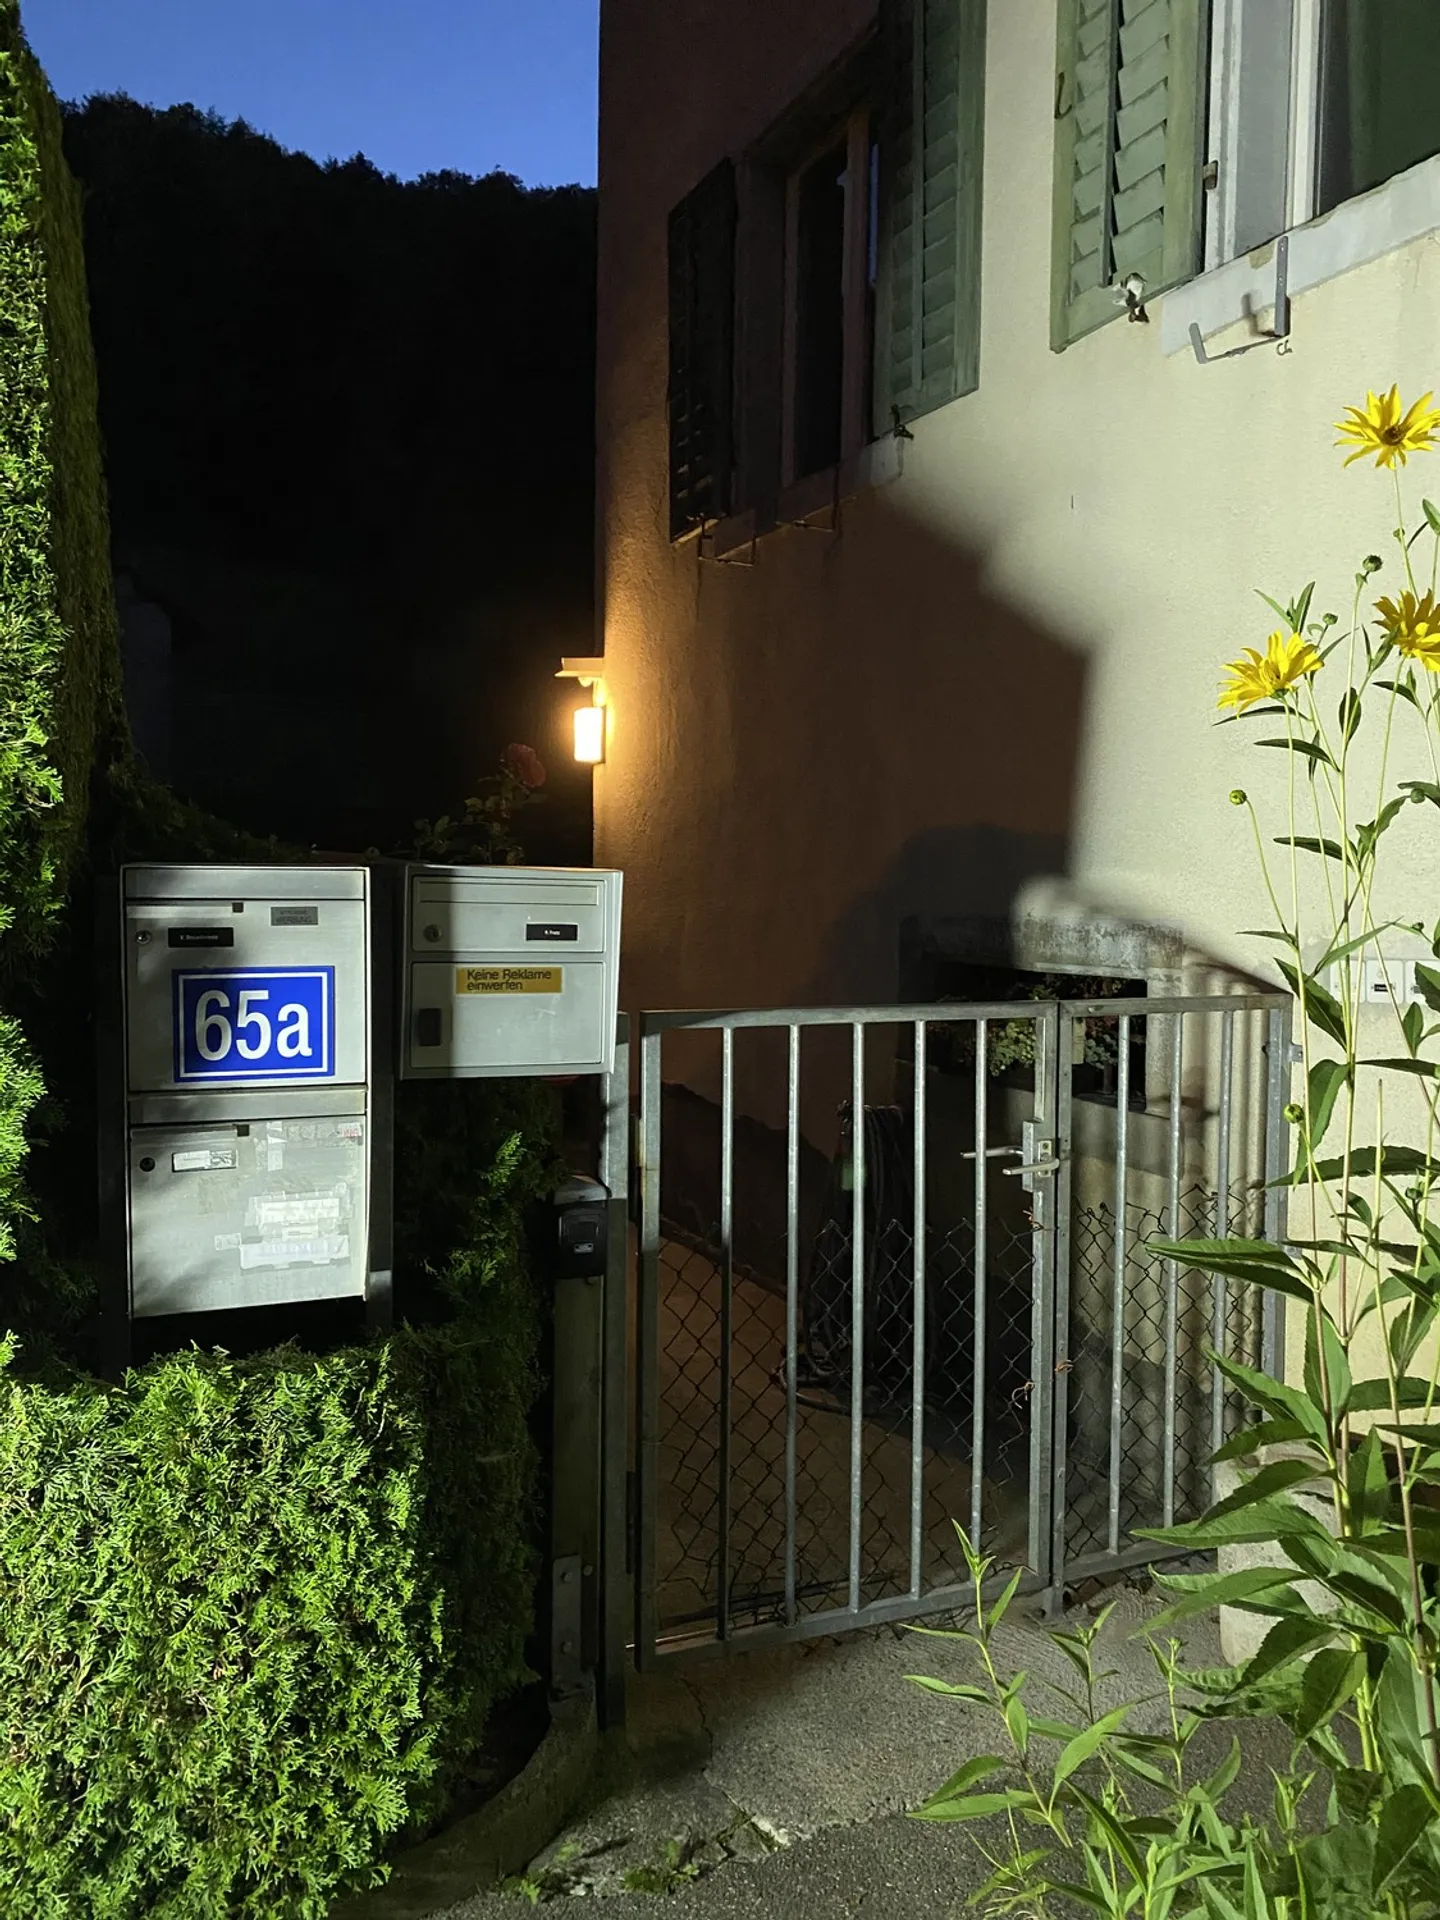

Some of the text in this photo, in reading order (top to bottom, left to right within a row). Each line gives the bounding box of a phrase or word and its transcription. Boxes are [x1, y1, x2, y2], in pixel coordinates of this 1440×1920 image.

[467, 969, 552, 980] Keine Reklame
[467, 980, 523, 991] einwerfen
[195, 989, 313, 1062] 65a
